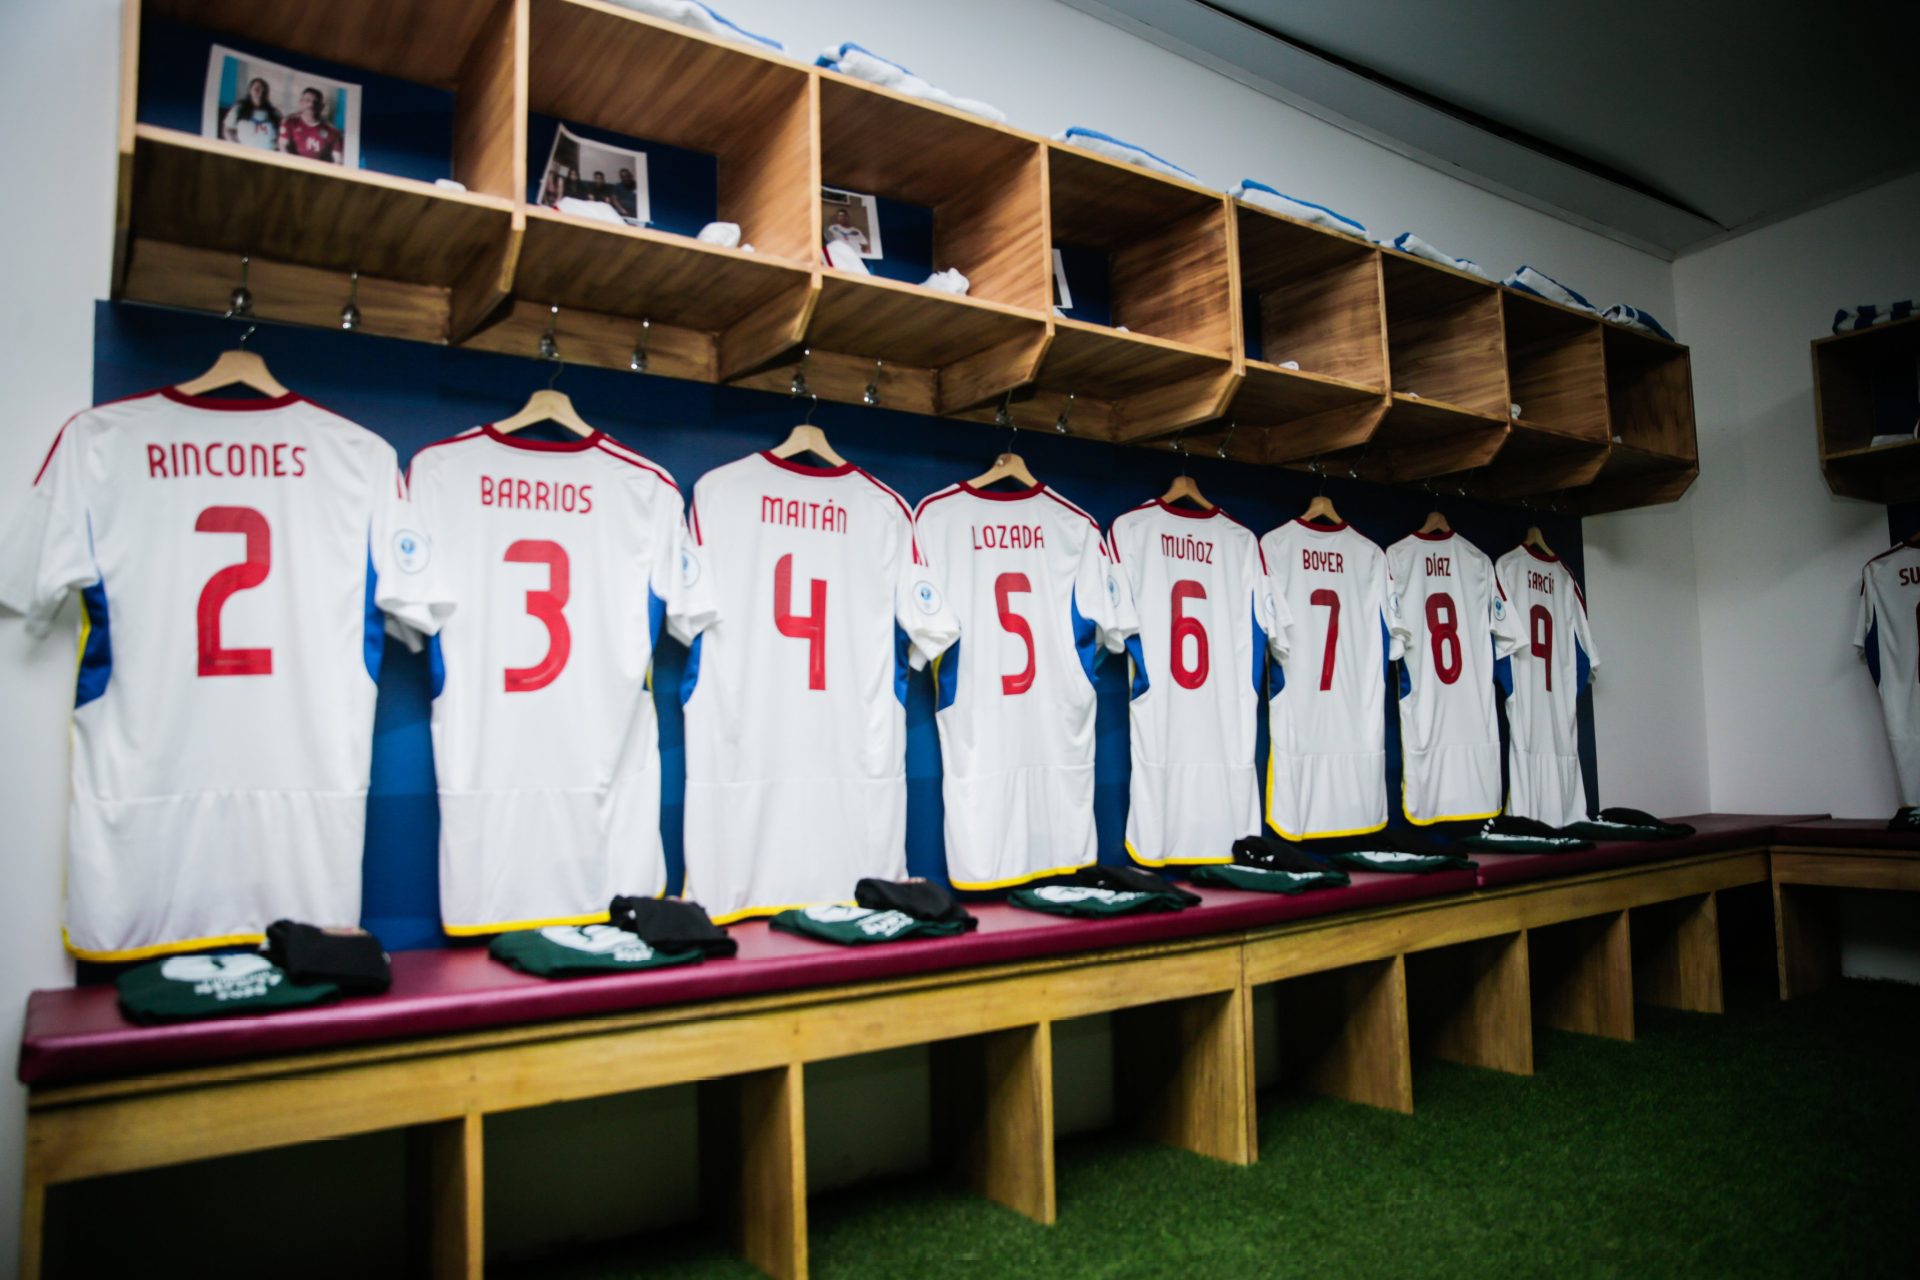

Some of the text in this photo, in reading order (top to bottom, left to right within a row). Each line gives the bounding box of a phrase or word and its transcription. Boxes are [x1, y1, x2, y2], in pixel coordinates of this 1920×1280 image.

[148, 442, 305, 479] RINCONES
[481, 475, 592, 514] BARRIOS
[761, 494, 847, 535] MAITÁN
[972, 524, 1044, 550] LOZADA
[1161, 533, 1214, 565] MUÑOZ
[194, 504, 272, 677] 2
[1302, 549, 1344, 573] BOYER
[1426, 552, 1451, 577] DÍAZ
[503, 539, 571, 692] 3
[774, 553, 827, 691] 4
[994, 572, 1036, 696] 5
[1170, 579, 1209, 690] 6
[1310, 588, 1340, 691] 7
[1425, 592, 1463, 684] 8
[1530, 604, 1553, 692] 9
